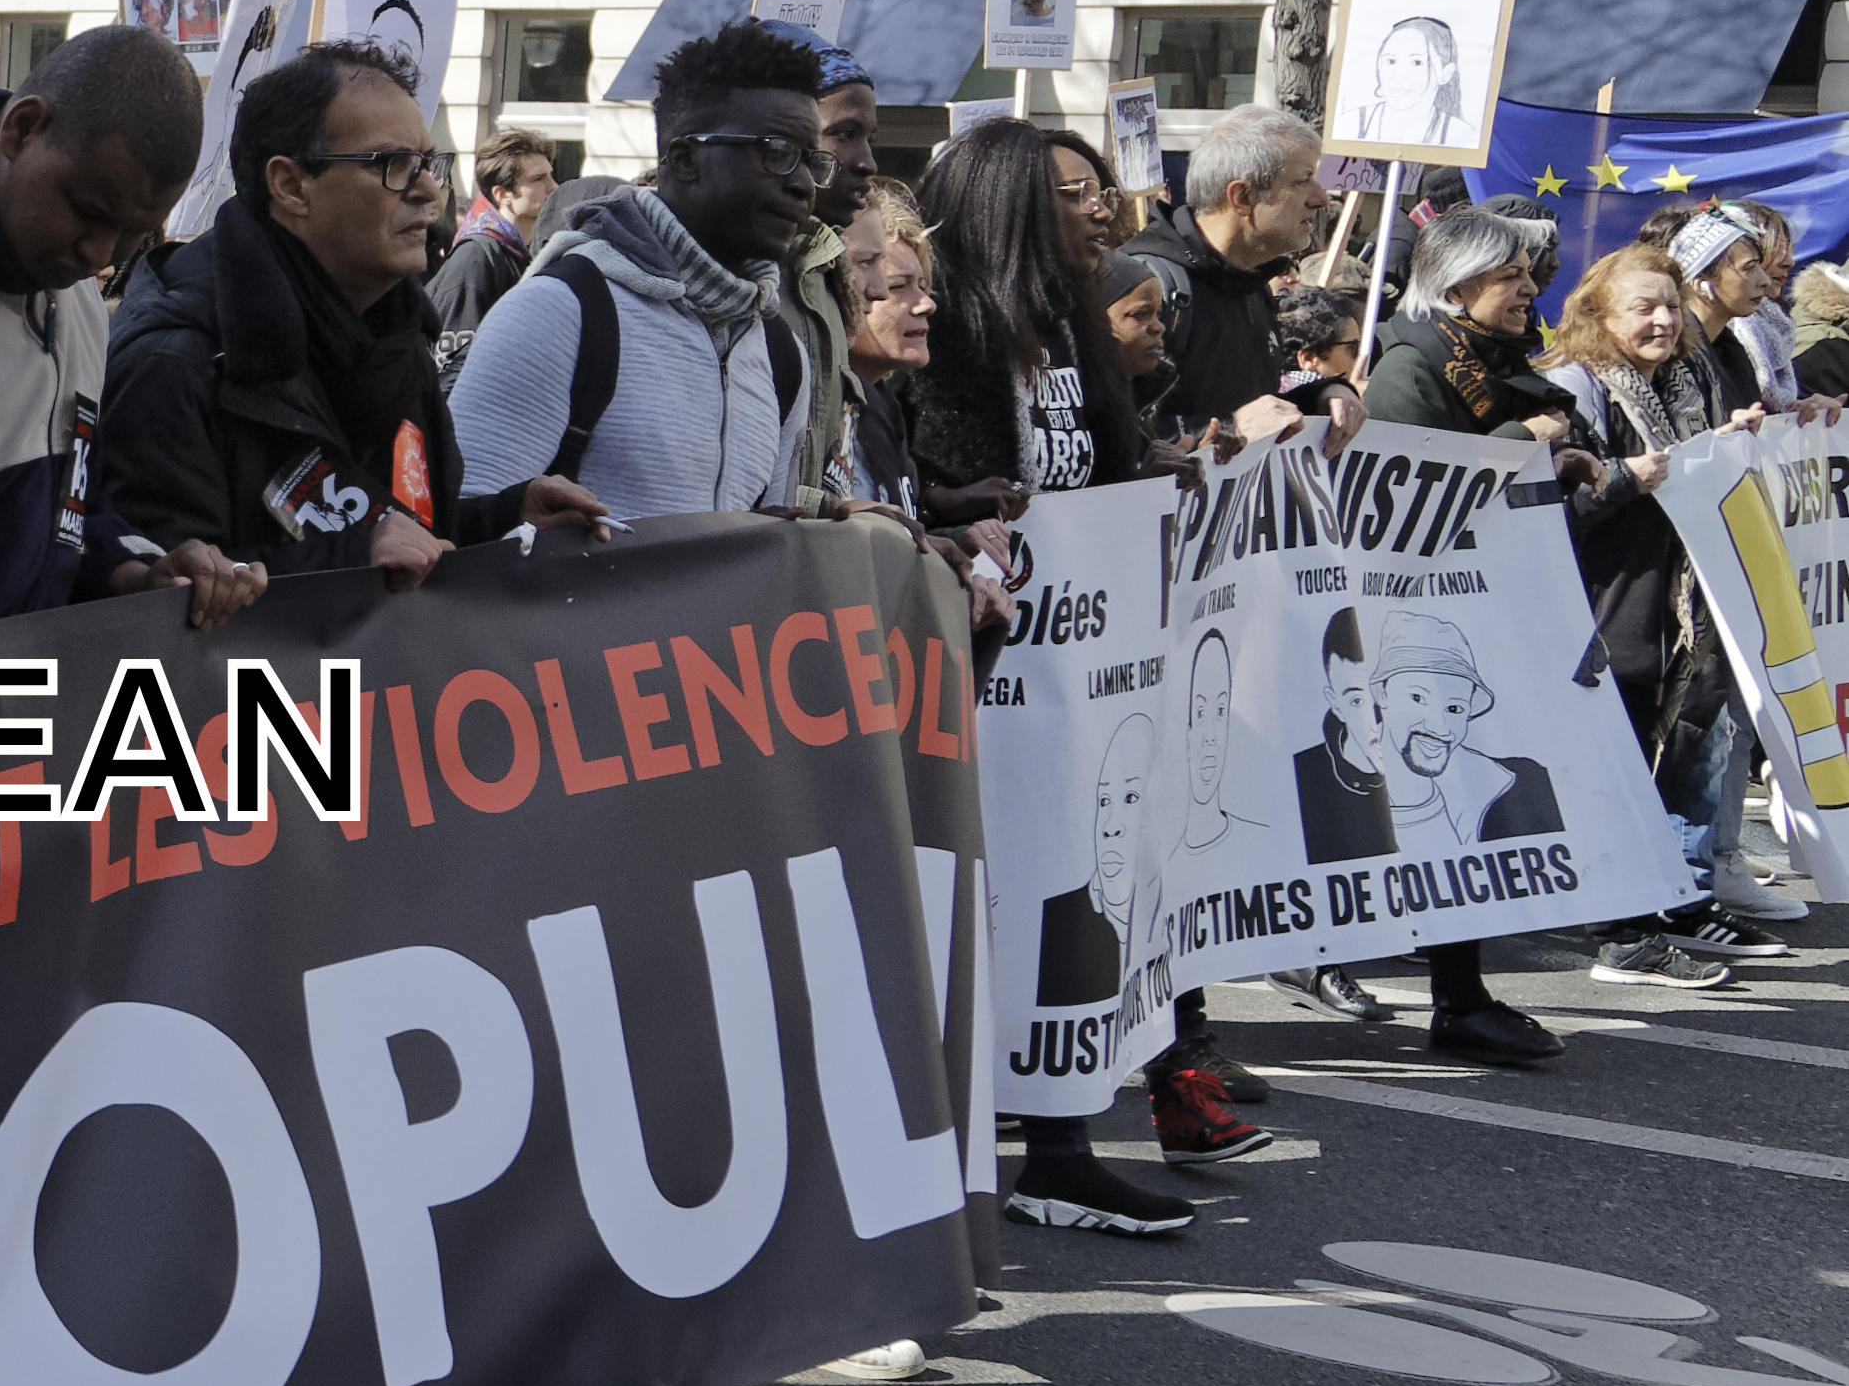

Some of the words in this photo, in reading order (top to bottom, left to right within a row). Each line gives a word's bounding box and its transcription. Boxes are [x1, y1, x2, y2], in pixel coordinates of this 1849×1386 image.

[1428, 570, 1489, 598] TANDIA
[1087, 662, 1136, 700] LAMINE
[1177, 878, 1316, 959] VICTIMES
[1327, 869, 1373, 927] DE
